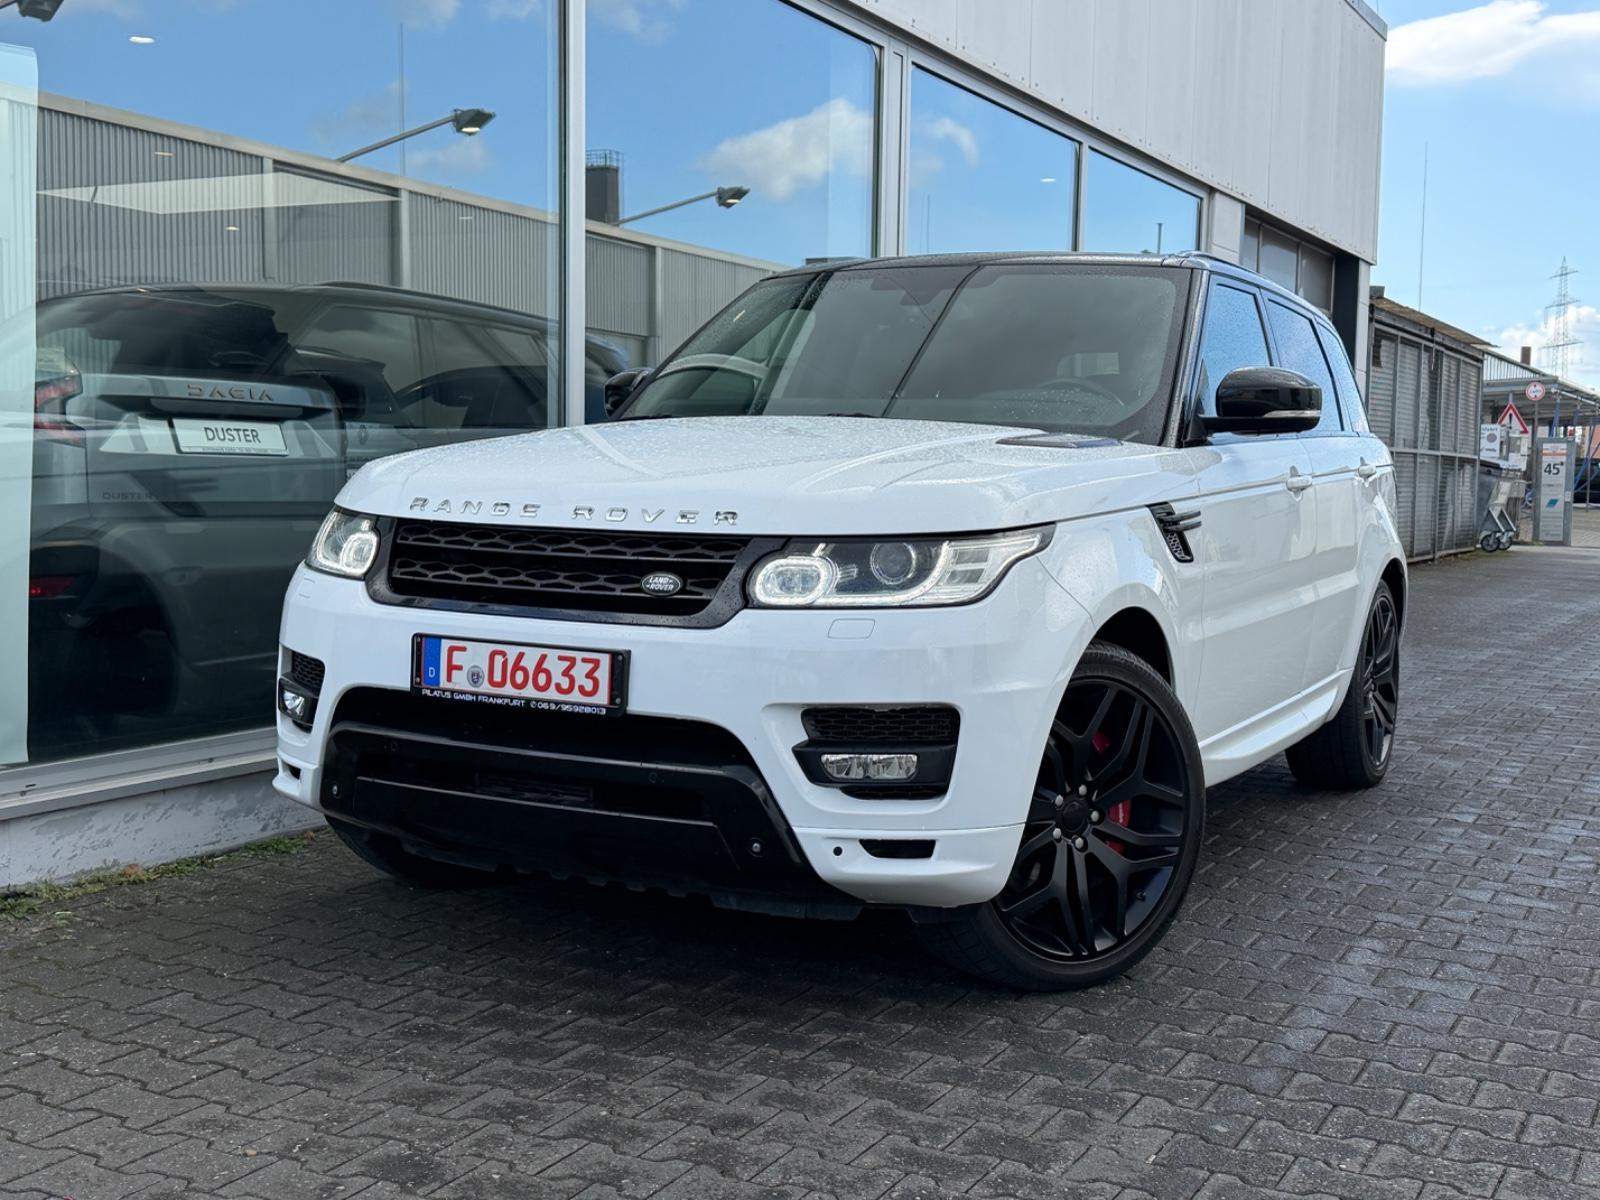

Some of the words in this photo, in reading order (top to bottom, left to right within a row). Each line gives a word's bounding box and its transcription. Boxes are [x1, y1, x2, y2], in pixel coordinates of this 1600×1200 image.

[187, 383, 275, 402] DACIA
[203, 426, 261, 444] DUSTER
[409, 497, 541, 518] RANGE
[570, 504, 739, 526] ROVER
[428, 666, 436, 679] D
[446, 645, 468, 683] F
[487, 649, 601, 698] 06633
[422, 688, 451, 699] PILATUS
[477, 695, 526, 707] FRANKFURT
